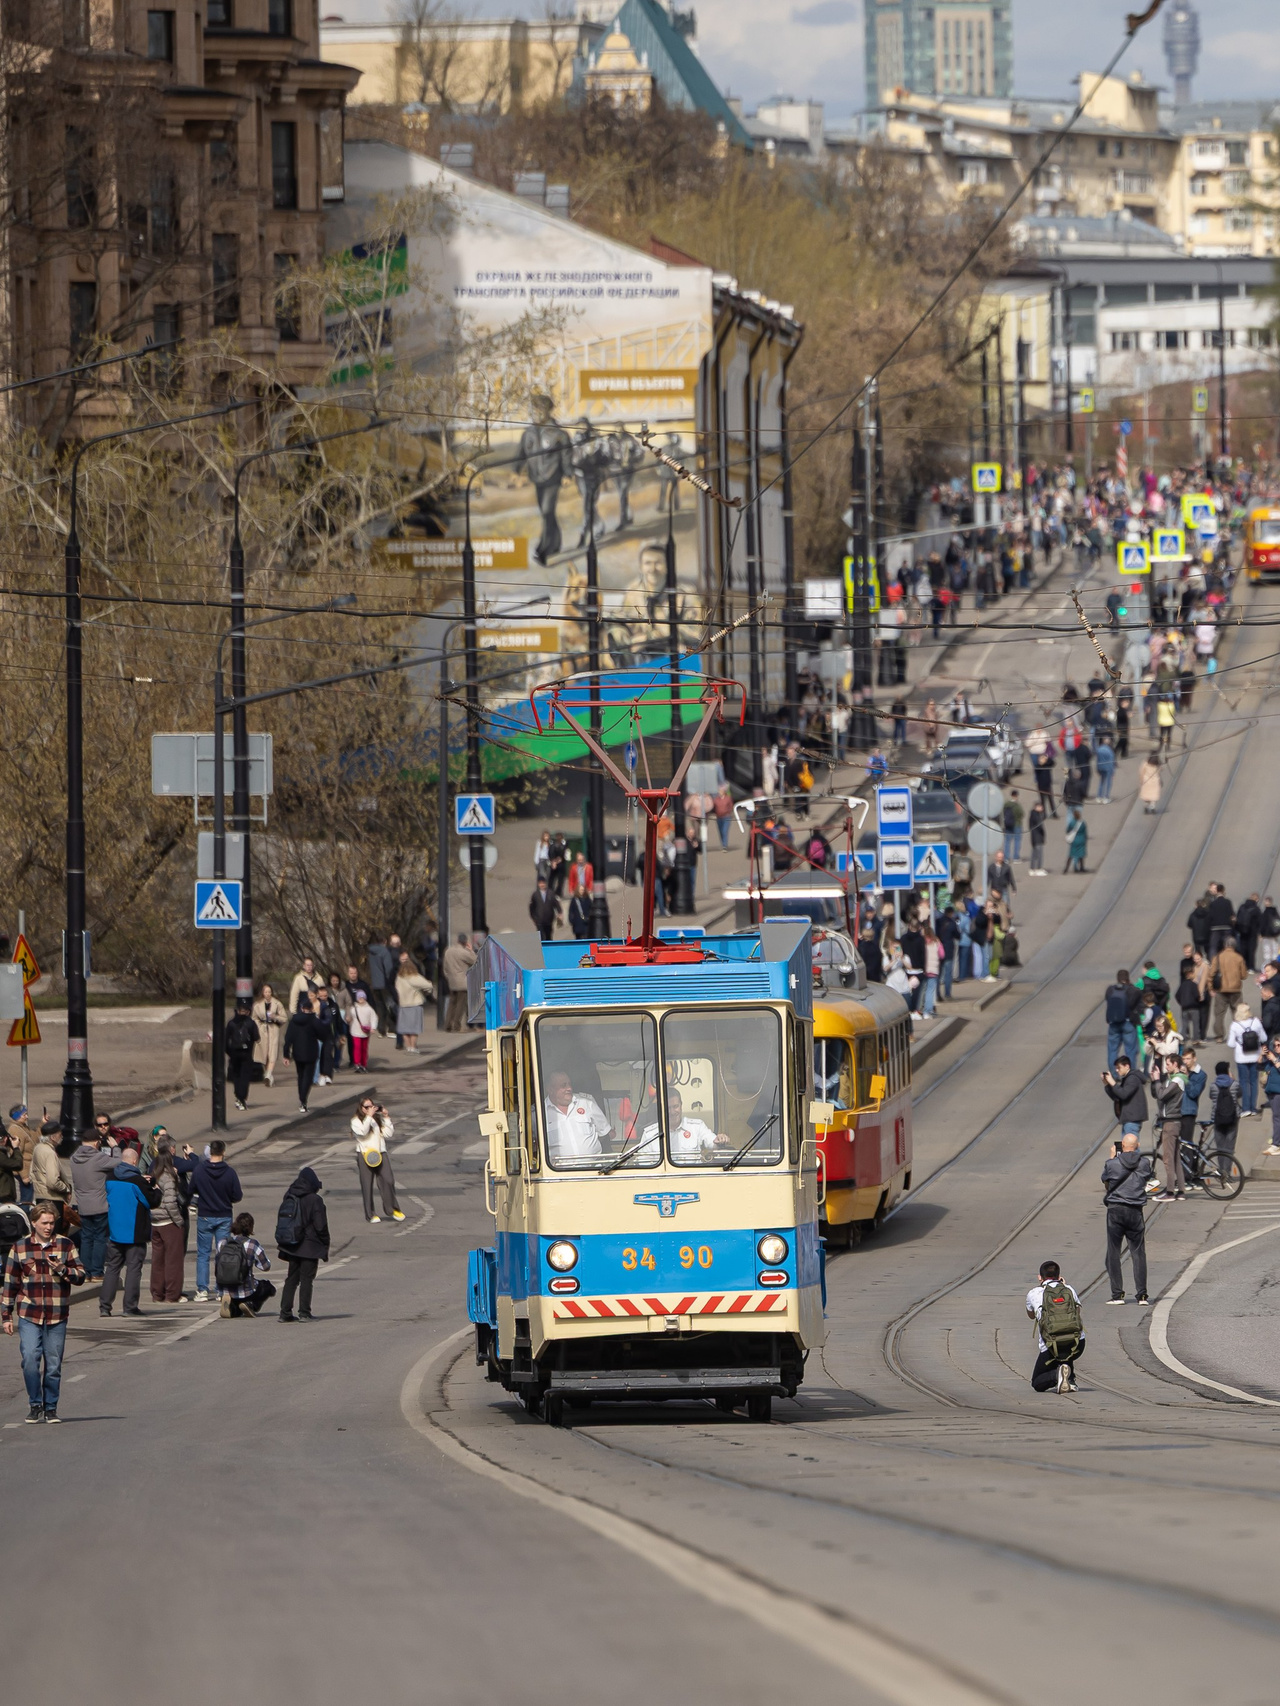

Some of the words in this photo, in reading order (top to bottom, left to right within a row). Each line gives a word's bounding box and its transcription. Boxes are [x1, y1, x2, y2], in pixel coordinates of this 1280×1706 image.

[476, 271, 521, 281] ОХРАНА
[525, 271, 653, 282] ЖЕЛЕЗНОДОРОЖНОГО
[454, 286, 526, 297] ТРАНСПОРТА
[530, 285, 603, 297] РОССИЙСКОЙ
[607, 286, 679, 298] ФЕДЕРАЦИИ
[622, 1247, 657, 1271] 34
[679, 1245, 713, 1269] 90
